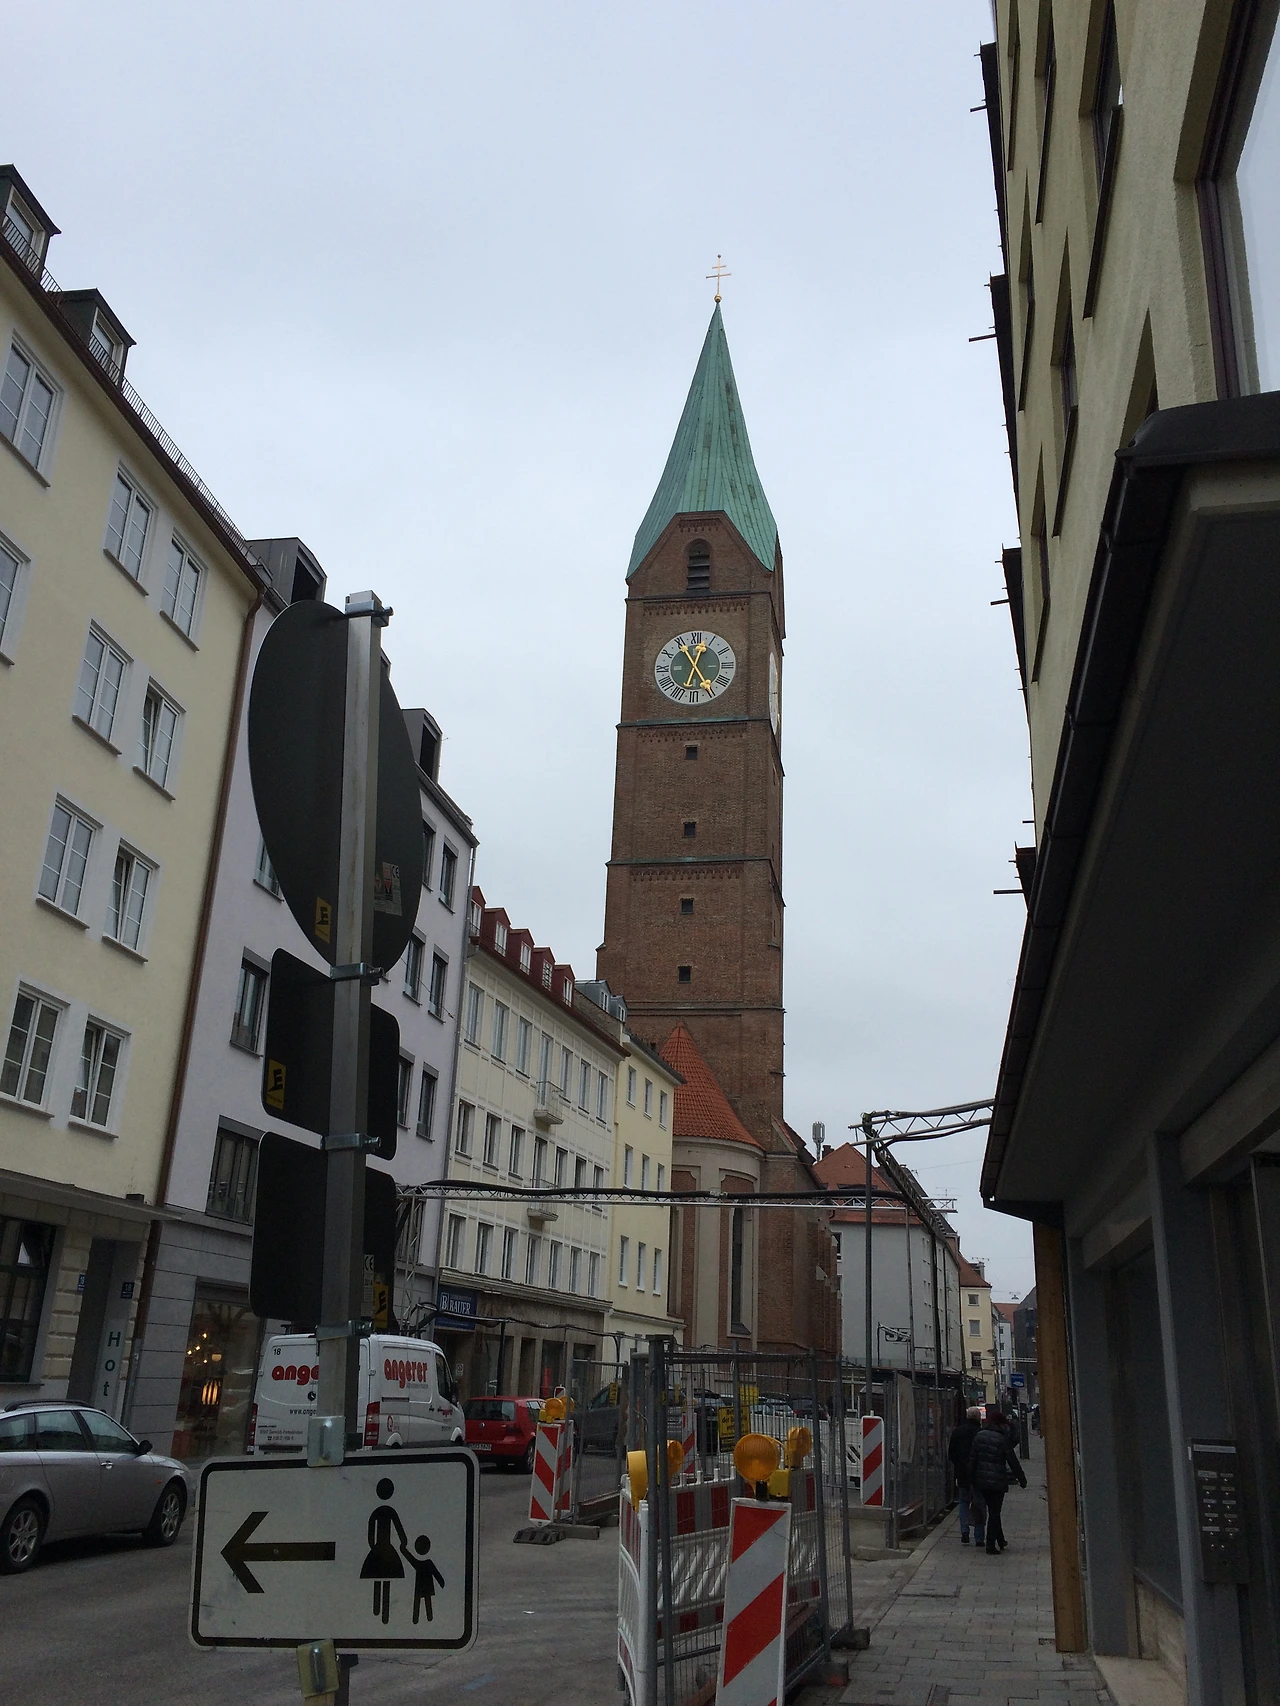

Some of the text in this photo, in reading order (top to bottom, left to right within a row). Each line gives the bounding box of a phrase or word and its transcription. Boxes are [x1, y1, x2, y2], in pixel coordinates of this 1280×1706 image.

[674, 636, 686, 649] XI
[691, 632, 702, 644] XII
[708, 636, 716, 646] I
[661, 649, 674, 658] X
[718, 646, 730, 656] II
[656, 665, 669, 673] IX
[721, 661, 734, 669] III
[273, 1347, 281, 1356] 18
[384, 1358, 428, 1389] angerer
